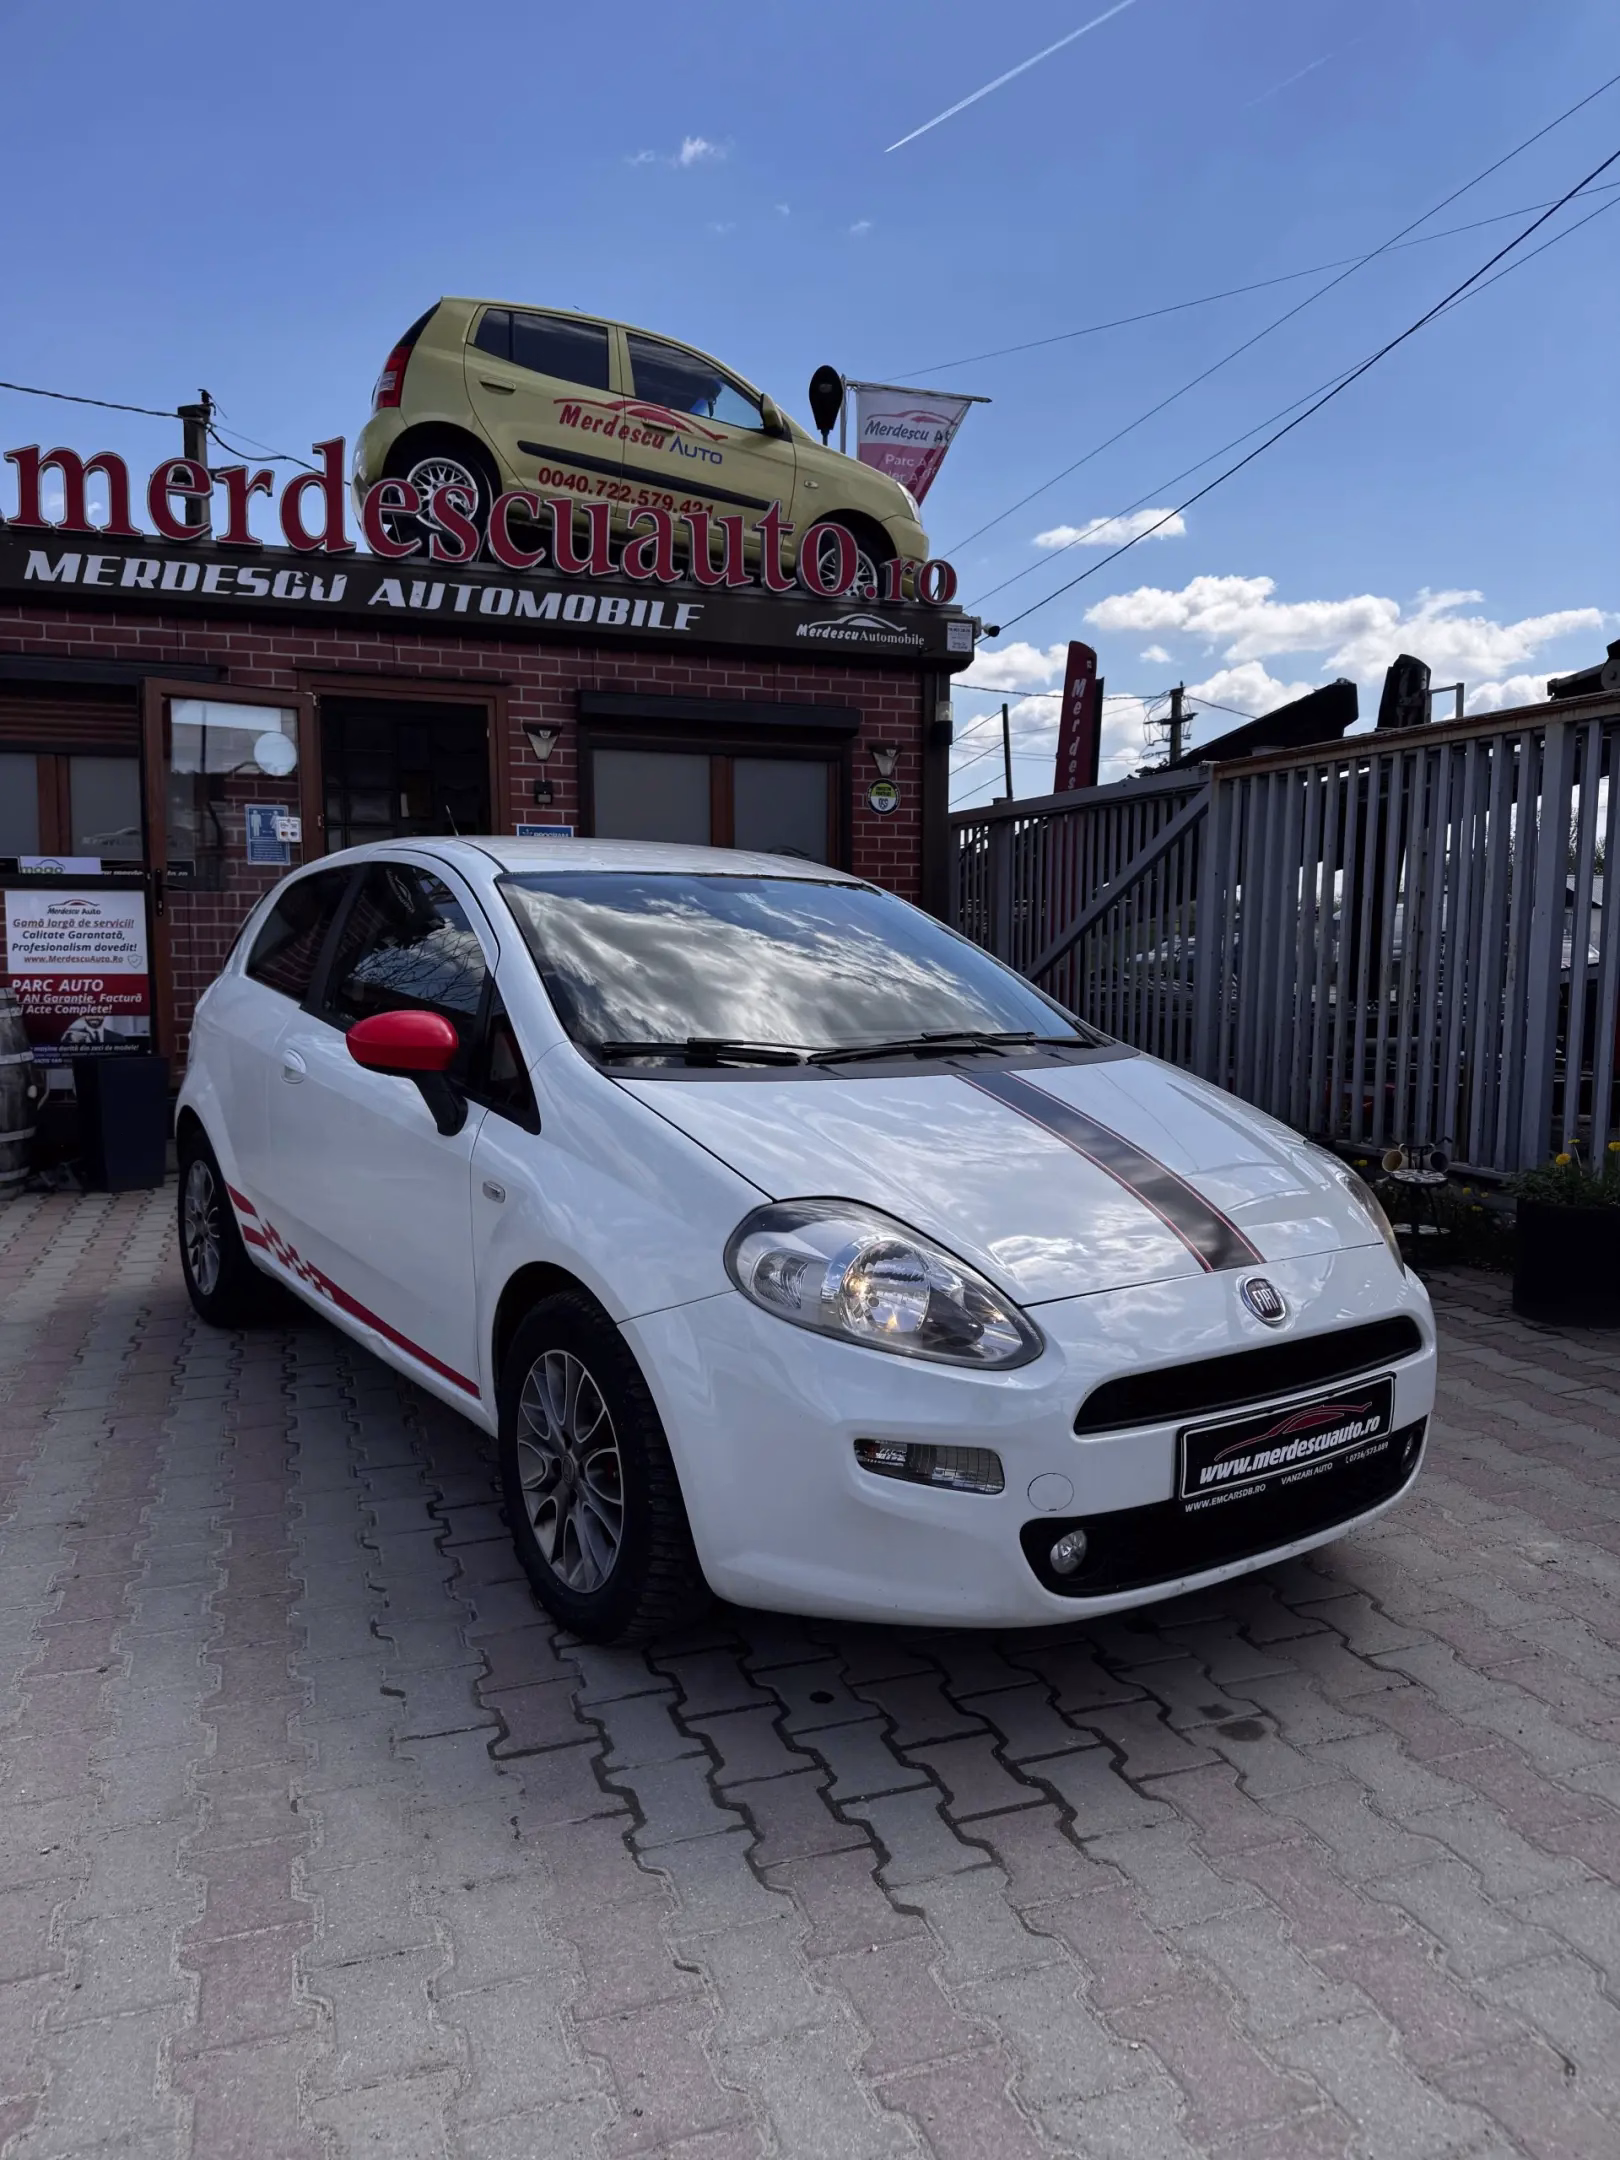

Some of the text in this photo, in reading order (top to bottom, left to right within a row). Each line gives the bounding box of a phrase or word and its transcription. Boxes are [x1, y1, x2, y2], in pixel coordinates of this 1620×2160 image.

[559, 404, 665, 449] Merdescu
[865, 420, 929, 441] Merdescu
[885, 453, 915, 466] Parc
[368, 577, 704, 631] AUTOMOBILE
[796, 624, 925, 646] Merdescu Automobile
[1068, 678, 1087, 790] Merdes
[13, 918, 135, 930] Gamă largă de servicii!
[22, 930, 65, 940] Calitate
[12, 943, 137, 954] Profesionalism dovedit!
[12, 979, 104, 992] PARC AUTO
[23, 994, 41, 1003] AN
[99, 993, 143, 1003] Factură
[26, 1005, 52, 1014] Acte
[54, 1004, 113, 1016] Complete!
[1252, 1288, 1279, 1311] FIAT
[1199, 1415, 1380, 1484] www.merdescuauto.ro
[1280, 1462, 1334, 1486] VANZARI AUTO
